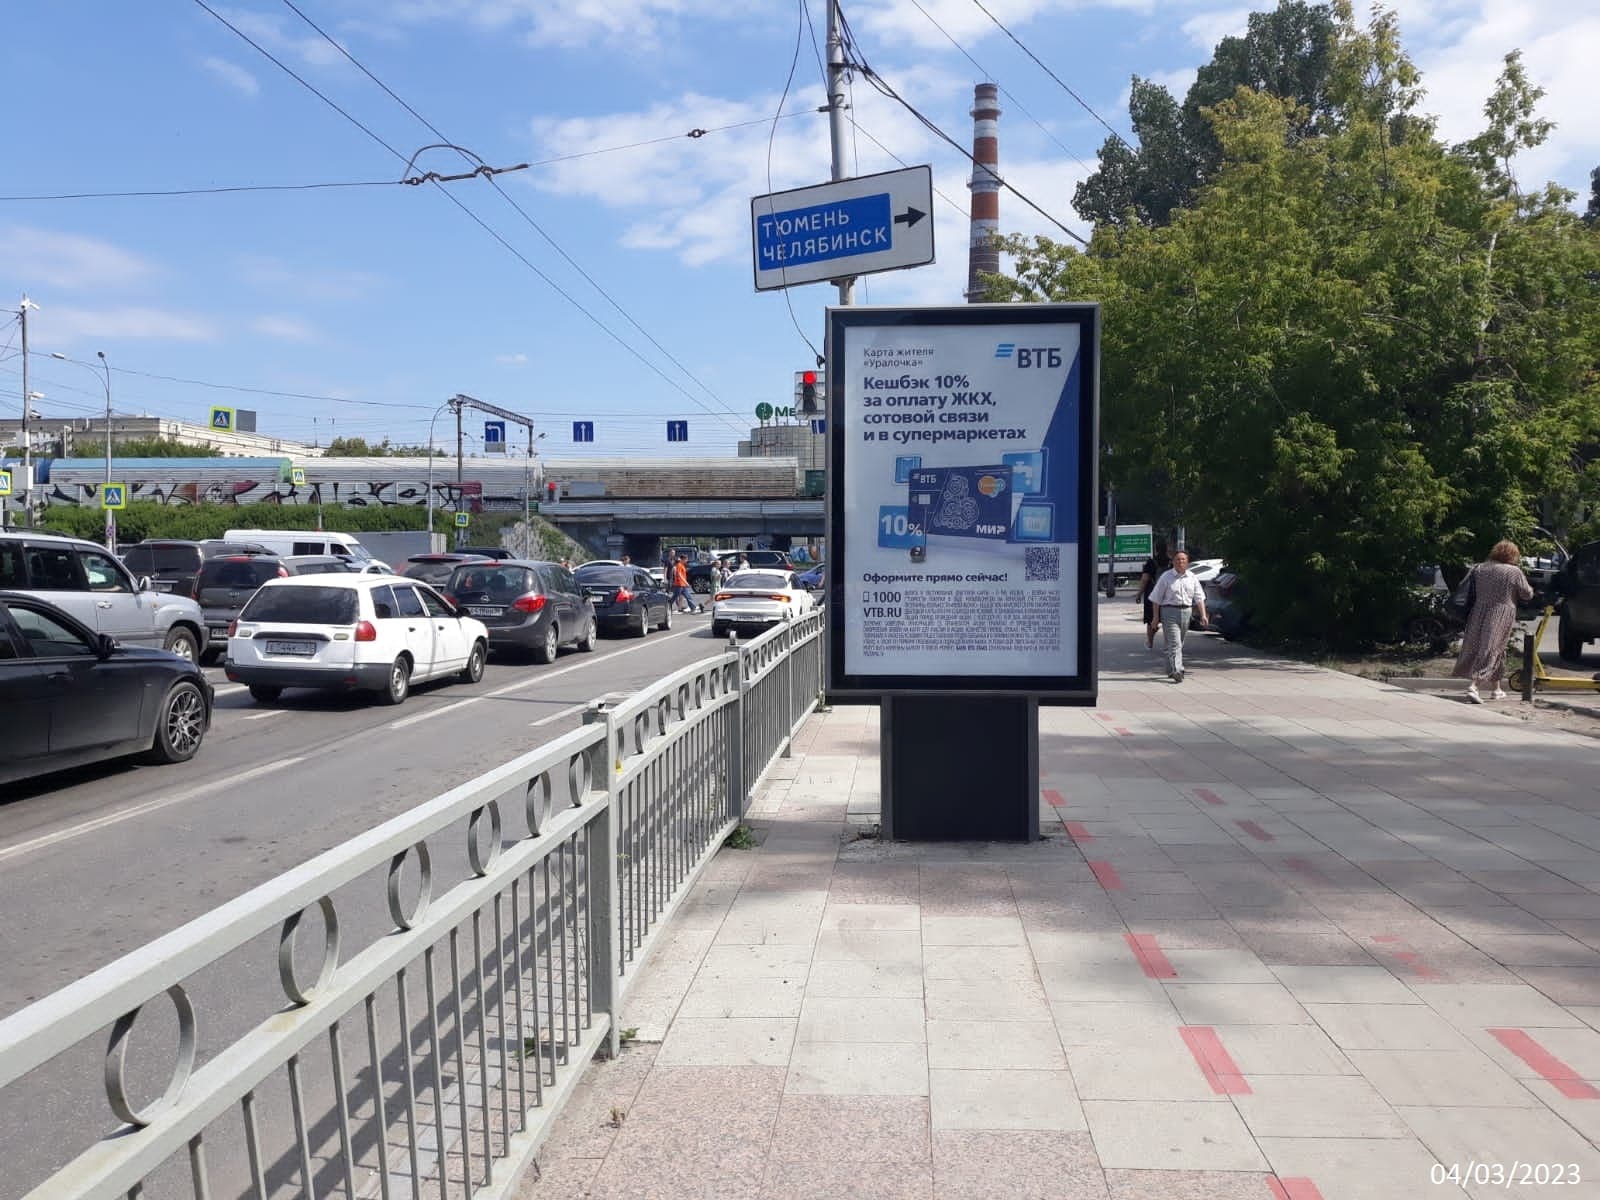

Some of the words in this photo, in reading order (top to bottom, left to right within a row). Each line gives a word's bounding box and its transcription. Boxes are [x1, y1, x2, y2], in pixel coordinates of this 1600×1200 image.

[762, 209, 850, 239] ТЮМЕНЬ
[763, 226, 888, 262] ЧЕЛЯБИНСК
[863, 347, 894, 359] Карта
[896, 347, 934, 357] жителя
[1017, 347, 1062, 369] ВТБ
[863, 358, 924, 369] «Уралочка»
[863, 375, 930, 390] Кешбэк
[934, 375, 970, 389] 10%
[863, 396, 882, 407] за
[886, 394, 948, 410] оплату
[951, 391, 997, 407] ЖКХ,
[863, 409, 935, 424] сотовой
[939, 411, 989, 423] связи
[863, 430, 875, 441] и
[878, 430, 889, 441] в
[893, 428, 1026, 445] супермаркетах
[920, 474, 937, 484] ВТБ
[976, 524, 1006, 536] МИР
[863, 572, 924, 585] Оформите
[926, 573, 963, 584] прямо
[966, 572, 1008, 583] сейчас!
[873, 591, 902, 603] 1000
[863, 607, 902, 618] VTB.RU
